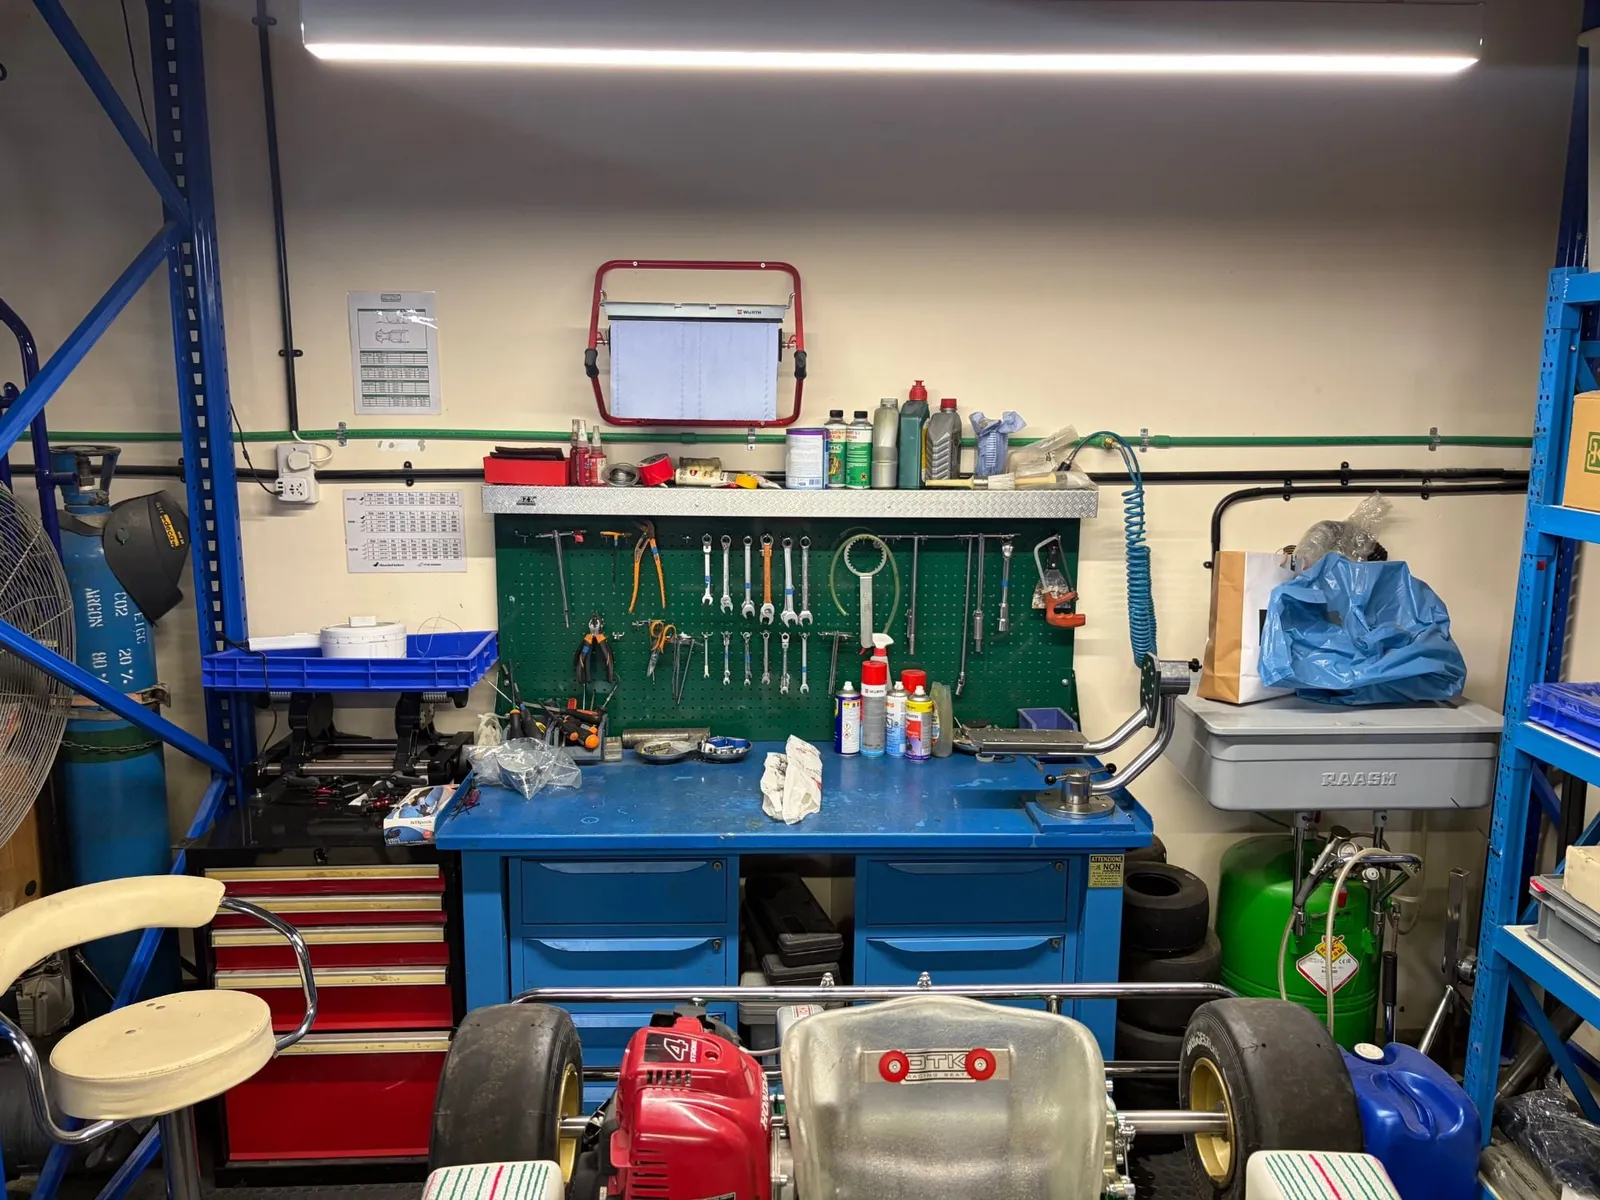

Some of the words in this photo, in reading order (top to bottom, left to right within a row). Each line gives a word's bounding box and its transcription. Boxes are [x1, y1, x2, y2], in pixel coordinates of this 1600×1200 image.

[85, 588, 104, 628] ARGON
[92, 652, 107, 669] 80
[118, 648, 132, 665] 20
[1321, 771, 1398, 787] RAASM
[664, 1037, 689, 1061] 4
[906, 1072, 938, 1080] RACING
[760, 1072, 769, 1131] HONDA
